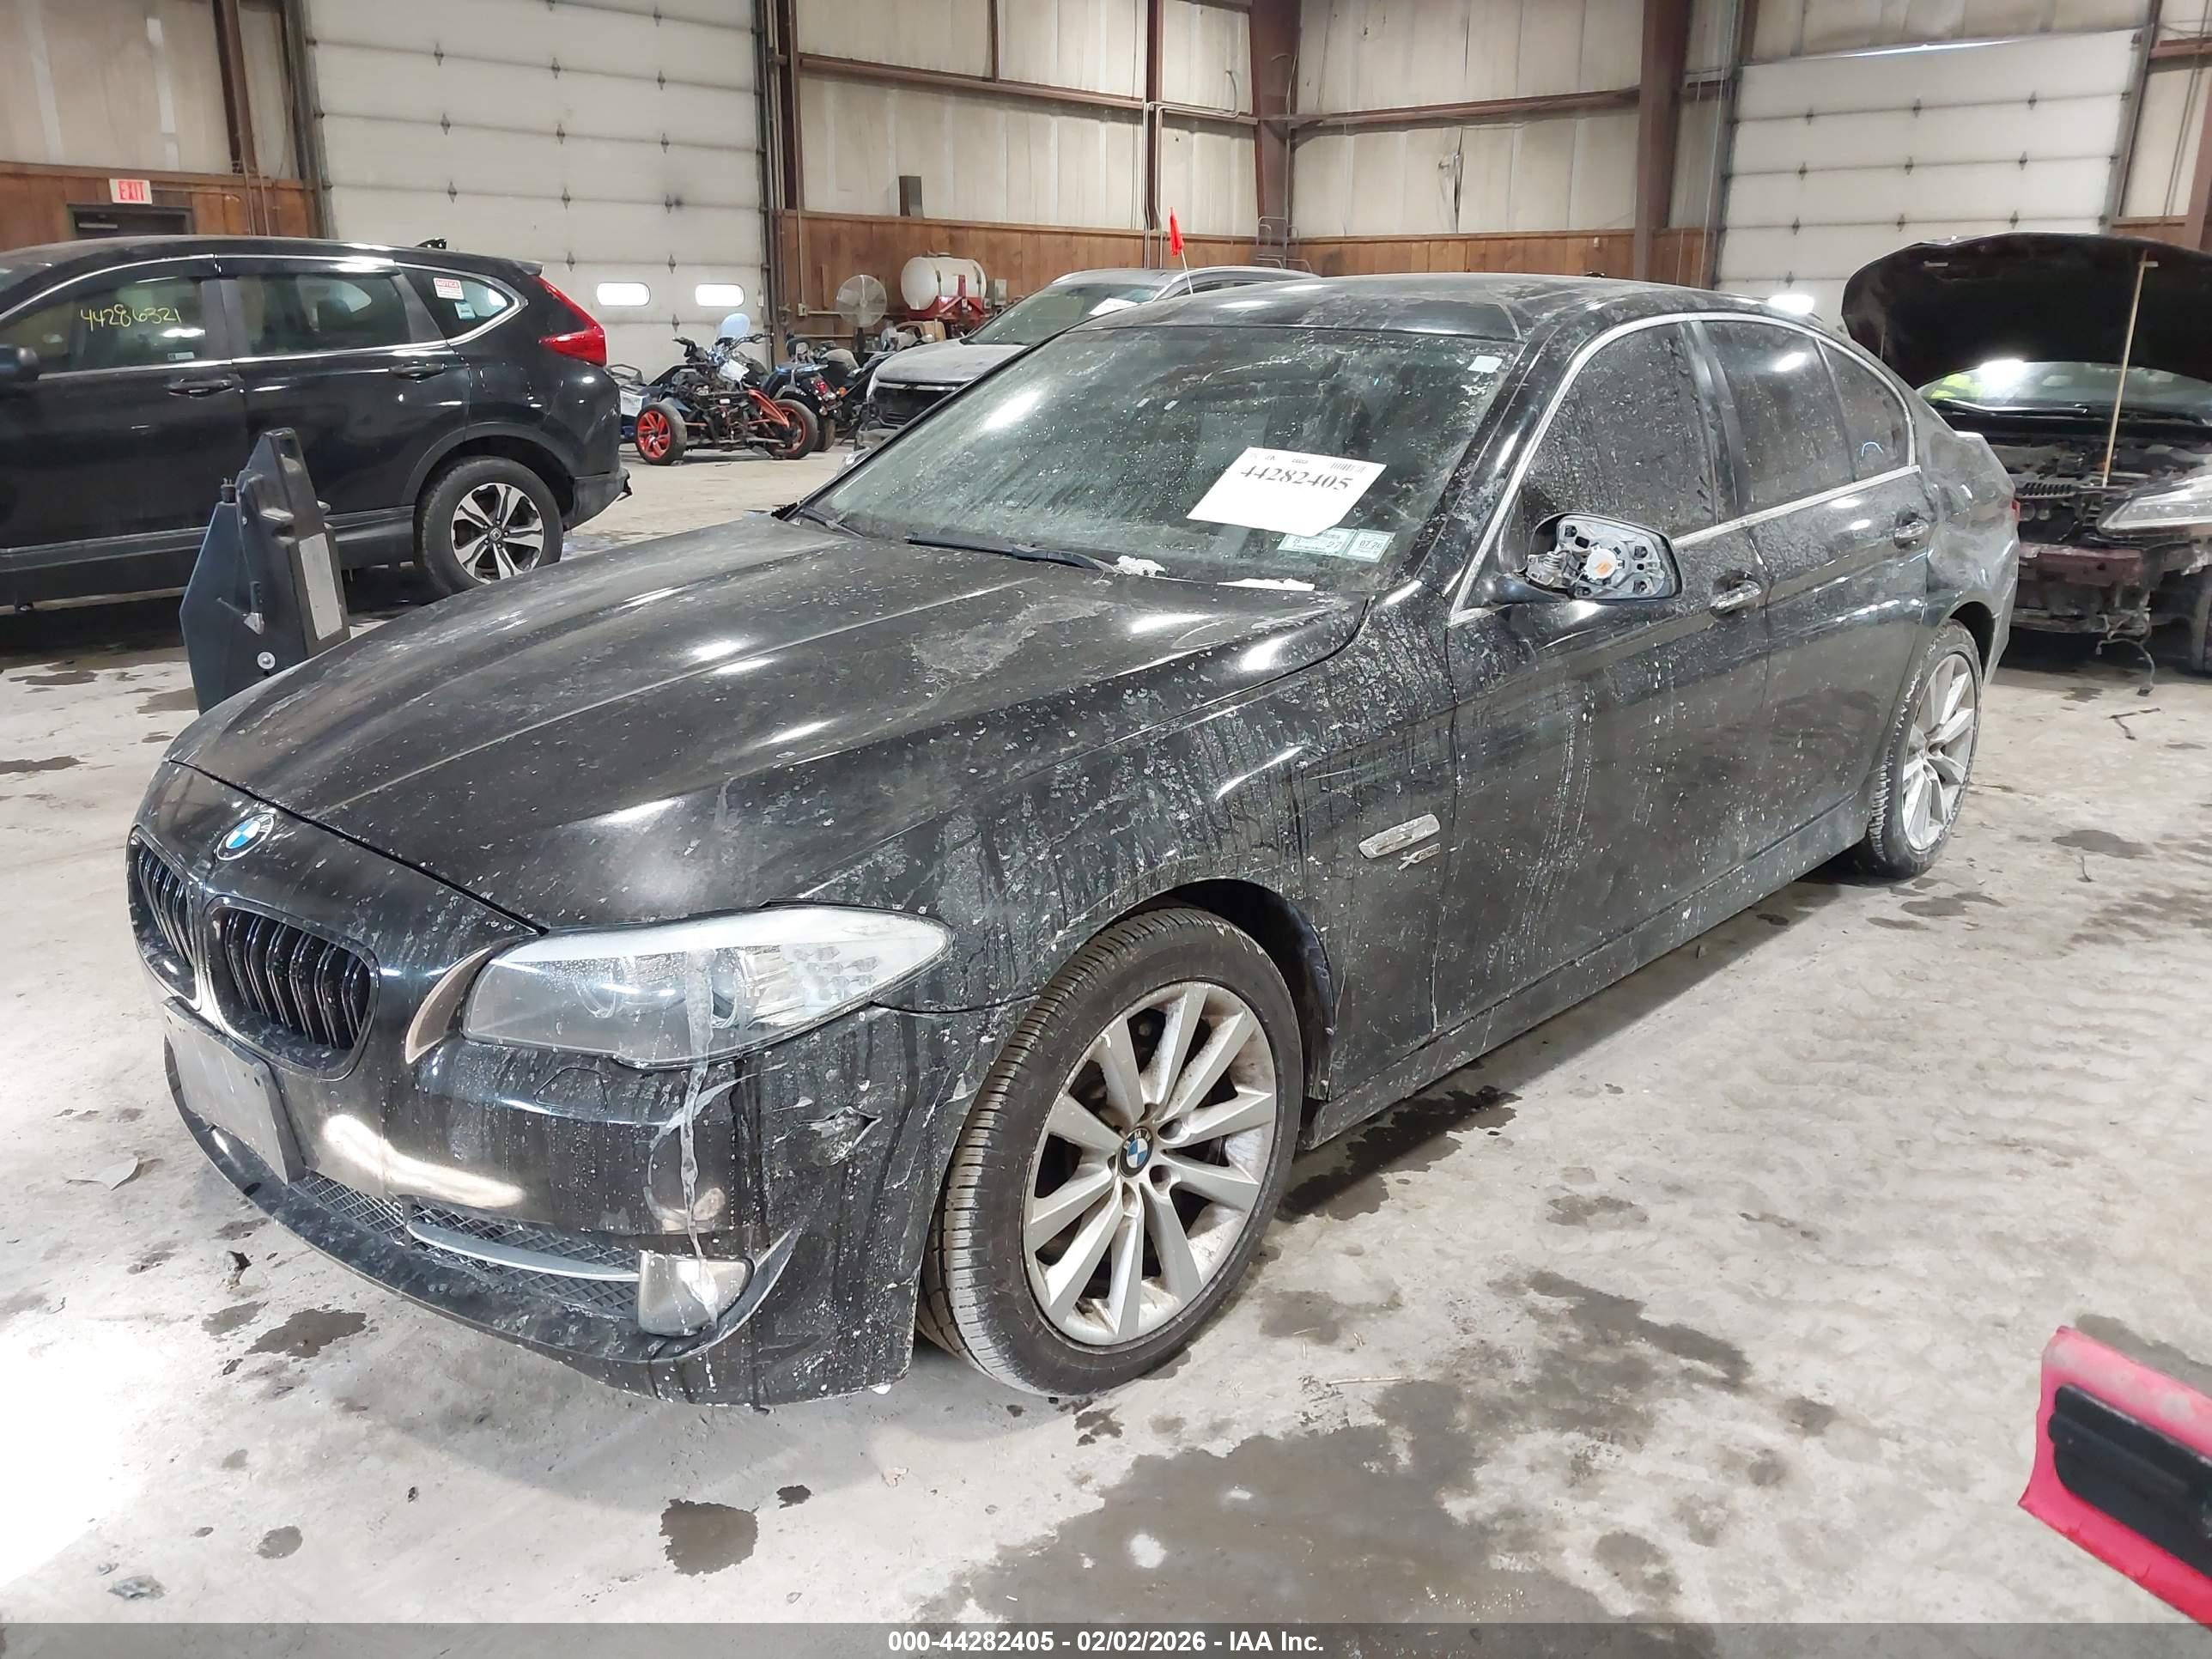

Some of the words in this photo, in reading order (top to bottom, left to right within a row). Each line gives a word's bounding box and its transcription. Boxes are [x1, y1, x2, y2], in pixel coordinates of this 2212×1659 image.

[118, 180, 145, 201] EXIT
[80, 303, 182, 332] 44286321
[1240, 465, 1353, 490] 44282405
[1123, 1129, 1152, 1152] BMW
